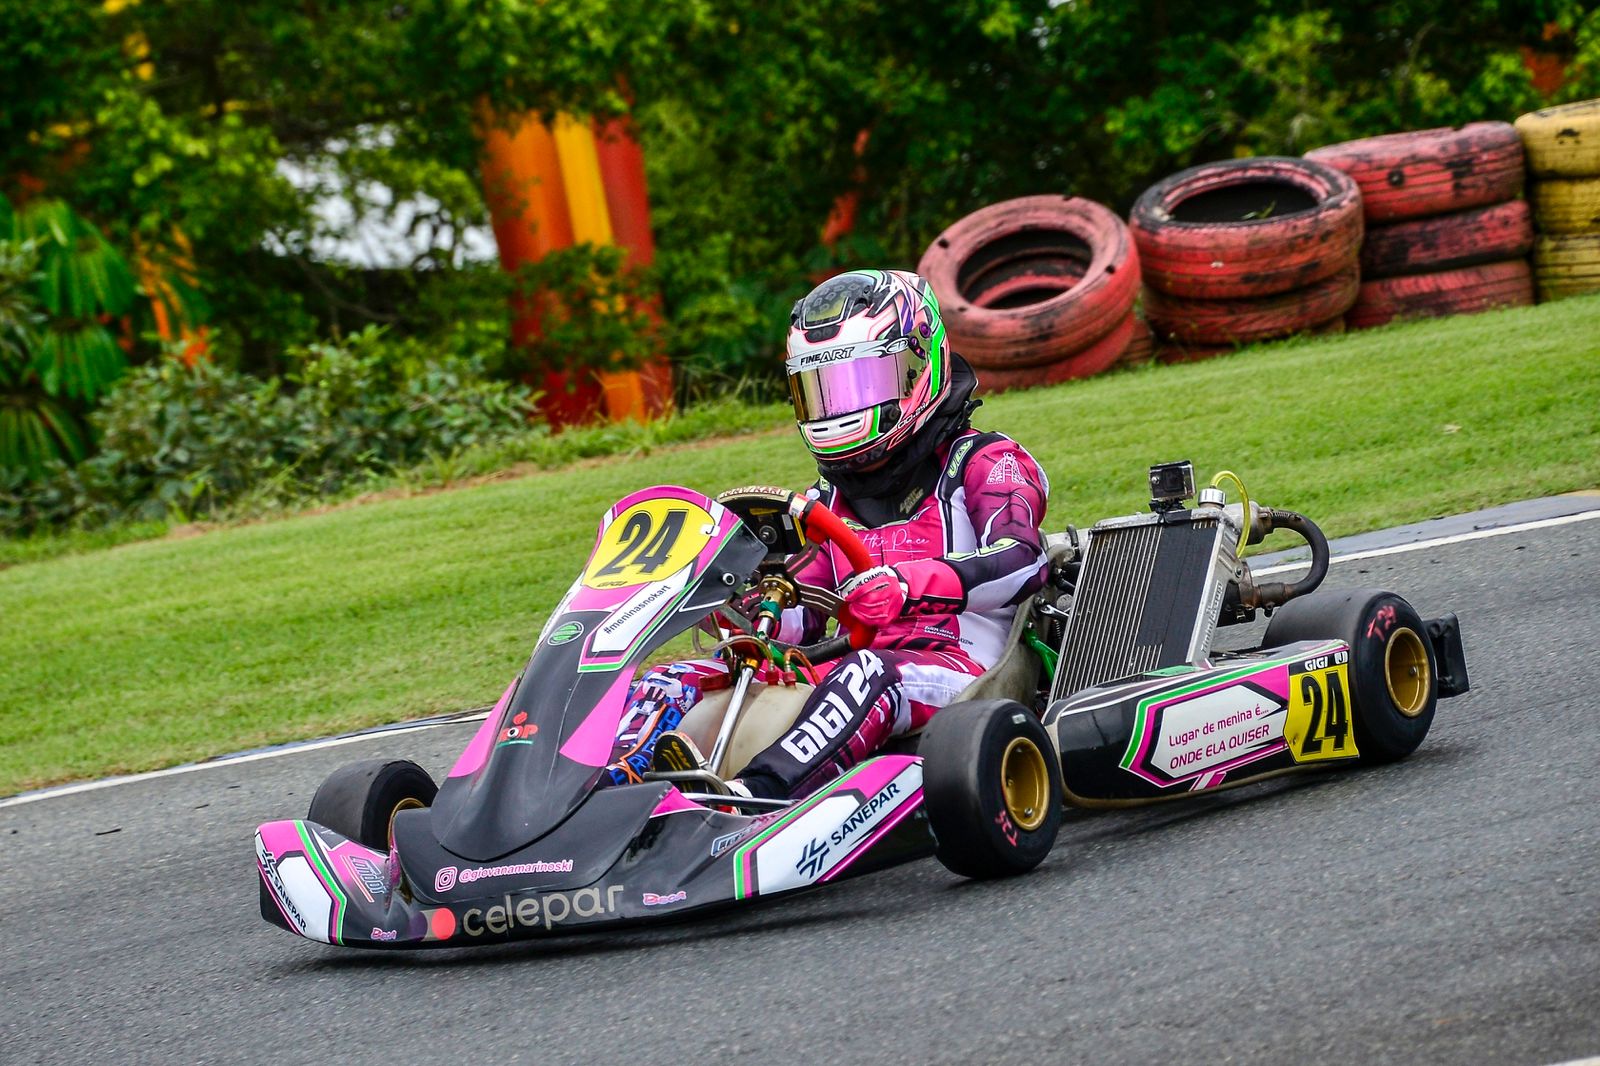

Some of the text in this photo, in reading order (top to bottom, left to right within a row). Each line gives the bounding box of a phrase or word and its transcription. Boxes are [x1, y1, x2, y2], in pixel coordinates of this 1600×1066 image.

[593, 508, 690, 575] 24
[603, 585, 672, 635] #meninasnokart
[1304, 655, 1329, 672] GIGI
[780, 649, 885, 764] GIGI 24
[1169, 728, 1200, 747] Lugar
[1202, 722, 1215, 735] de
[1217, 710, 1253, 731] menina
[1301, 670, 1349, 757] 24
[1169, 724, 1271, 770] ONDE ELA QUISER
[831, 782, 901, 847] SANEPAR
[459, 859, 574, 883] @giovanamarinoski
[272, 877, 308, 933] SANEPAR
[463, 884, 625, 937] celepar
